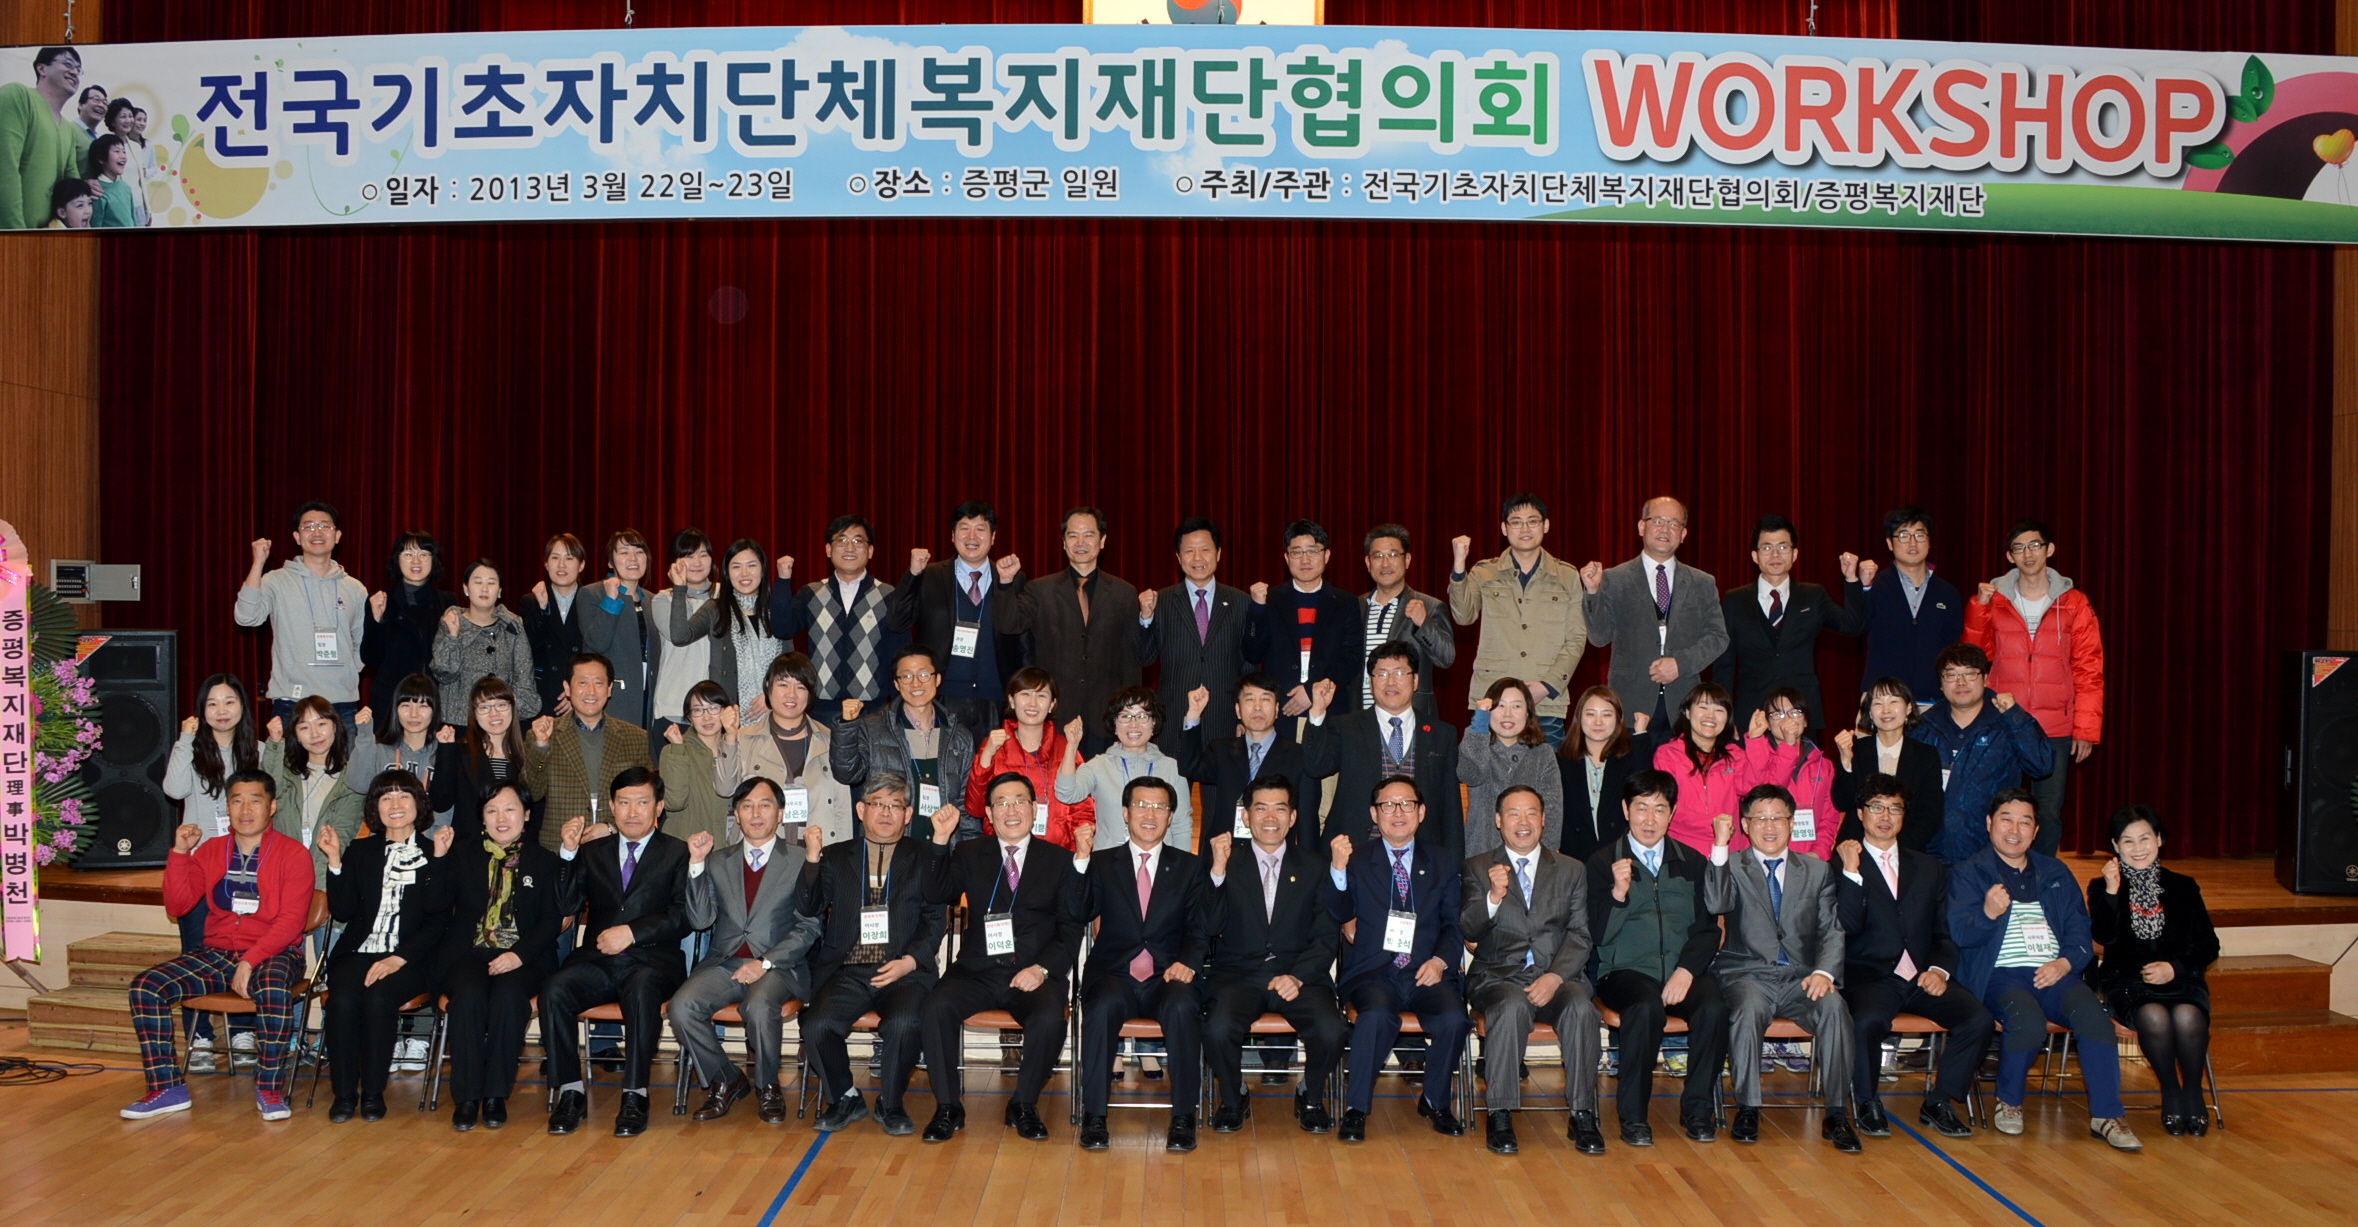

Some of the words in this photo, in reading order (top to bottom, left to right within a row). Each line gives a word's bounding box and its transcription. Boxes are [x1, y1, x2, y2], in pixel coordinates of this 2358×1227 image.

[196, 56, 1548, 157] 전국기초자치단체복지재단협의회
[1593, 59, 2215, 165] WORKSHOP
[386, 175, 440, 206] 일자
[470, 173, 570, 202] 2013년
[583, 172, 627, 202] 3월
[640, 170, 792, 200] 22일~23일
[874, 169, 931, 199] 장소
[962, 169, 1051, 199] 증평군
[1063, 169, 1118, 198] 일원
[1200, 169, 1331, 200] 주최/주관
[1363, 171, 1985, 215] 전국기초자치단체복지재단협의회/증평복지재단
[952, 644, 974, 655] 송영진
[2, 609, 28, 774] 증평복지재단
[4, 822, 29, 904] 박병천
